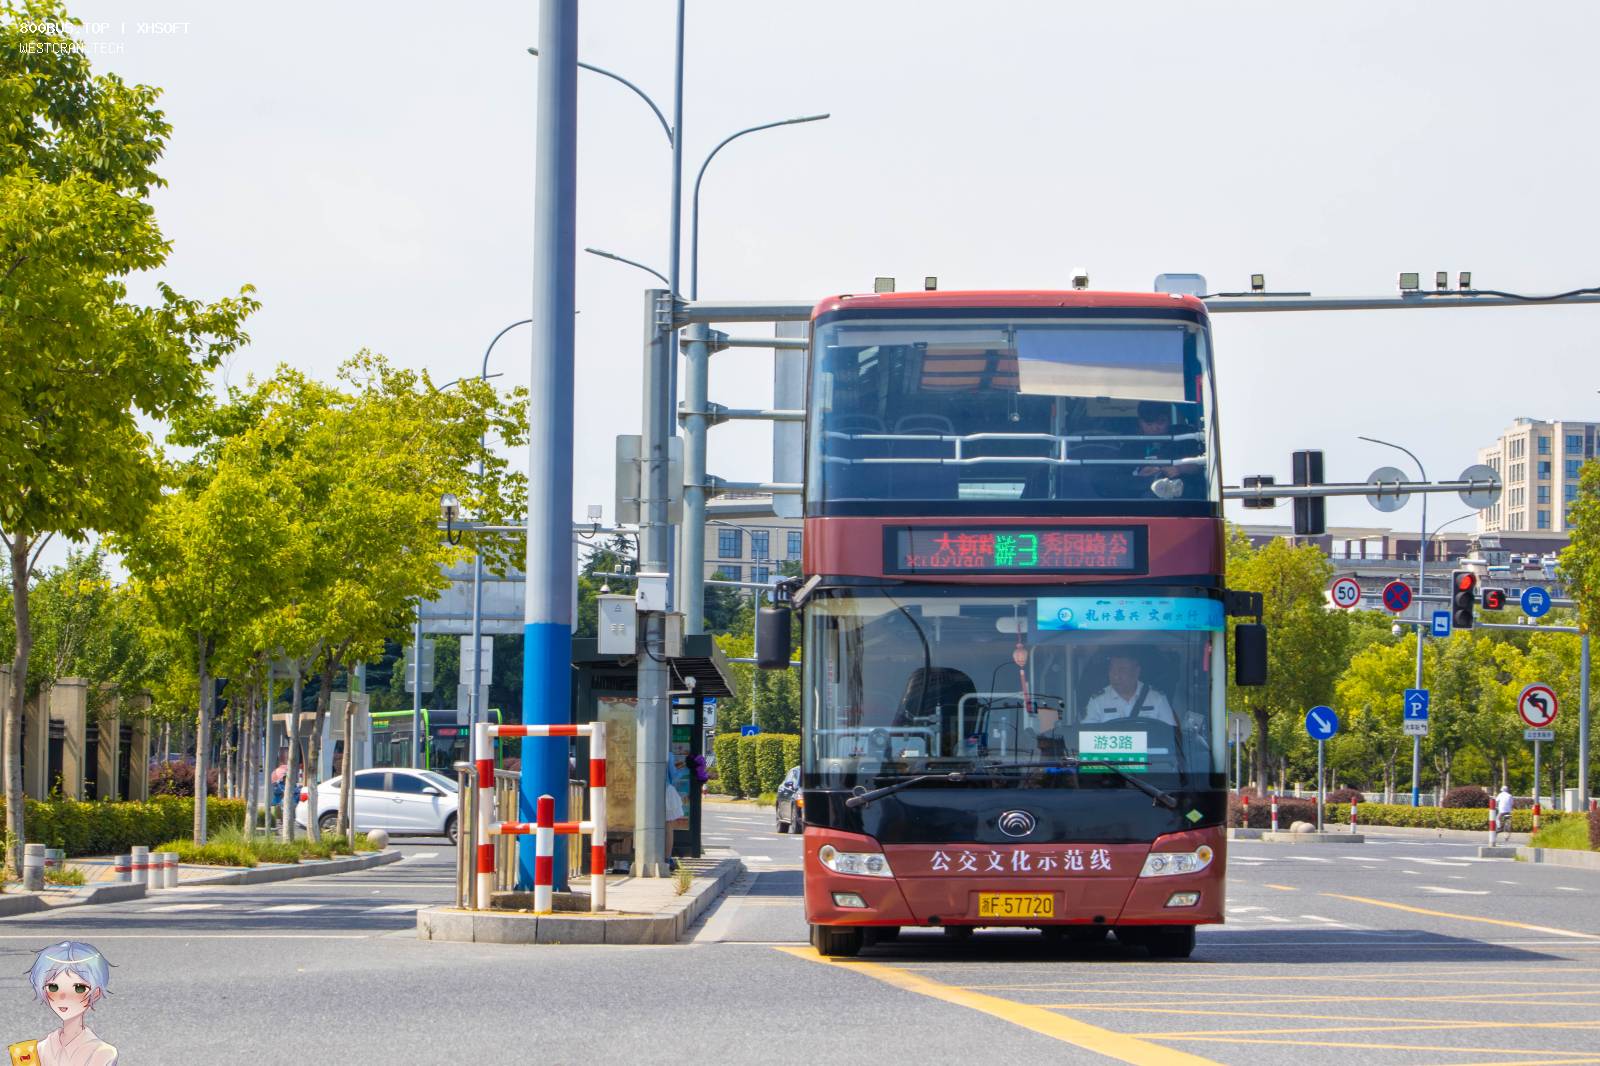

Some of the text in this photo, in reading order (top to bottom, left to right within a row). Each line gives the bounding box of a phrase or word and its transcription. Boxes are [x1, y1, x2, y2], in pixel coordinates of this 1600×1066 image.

[1338, 586, 1355, 599] 50
[1488, 591, 1498, 608] 5
[1411, 703, 1421, 717] P
[1094, 735, 1133, 750] 游3路
[930, 849, 1112, 871] 公交文化示范线
